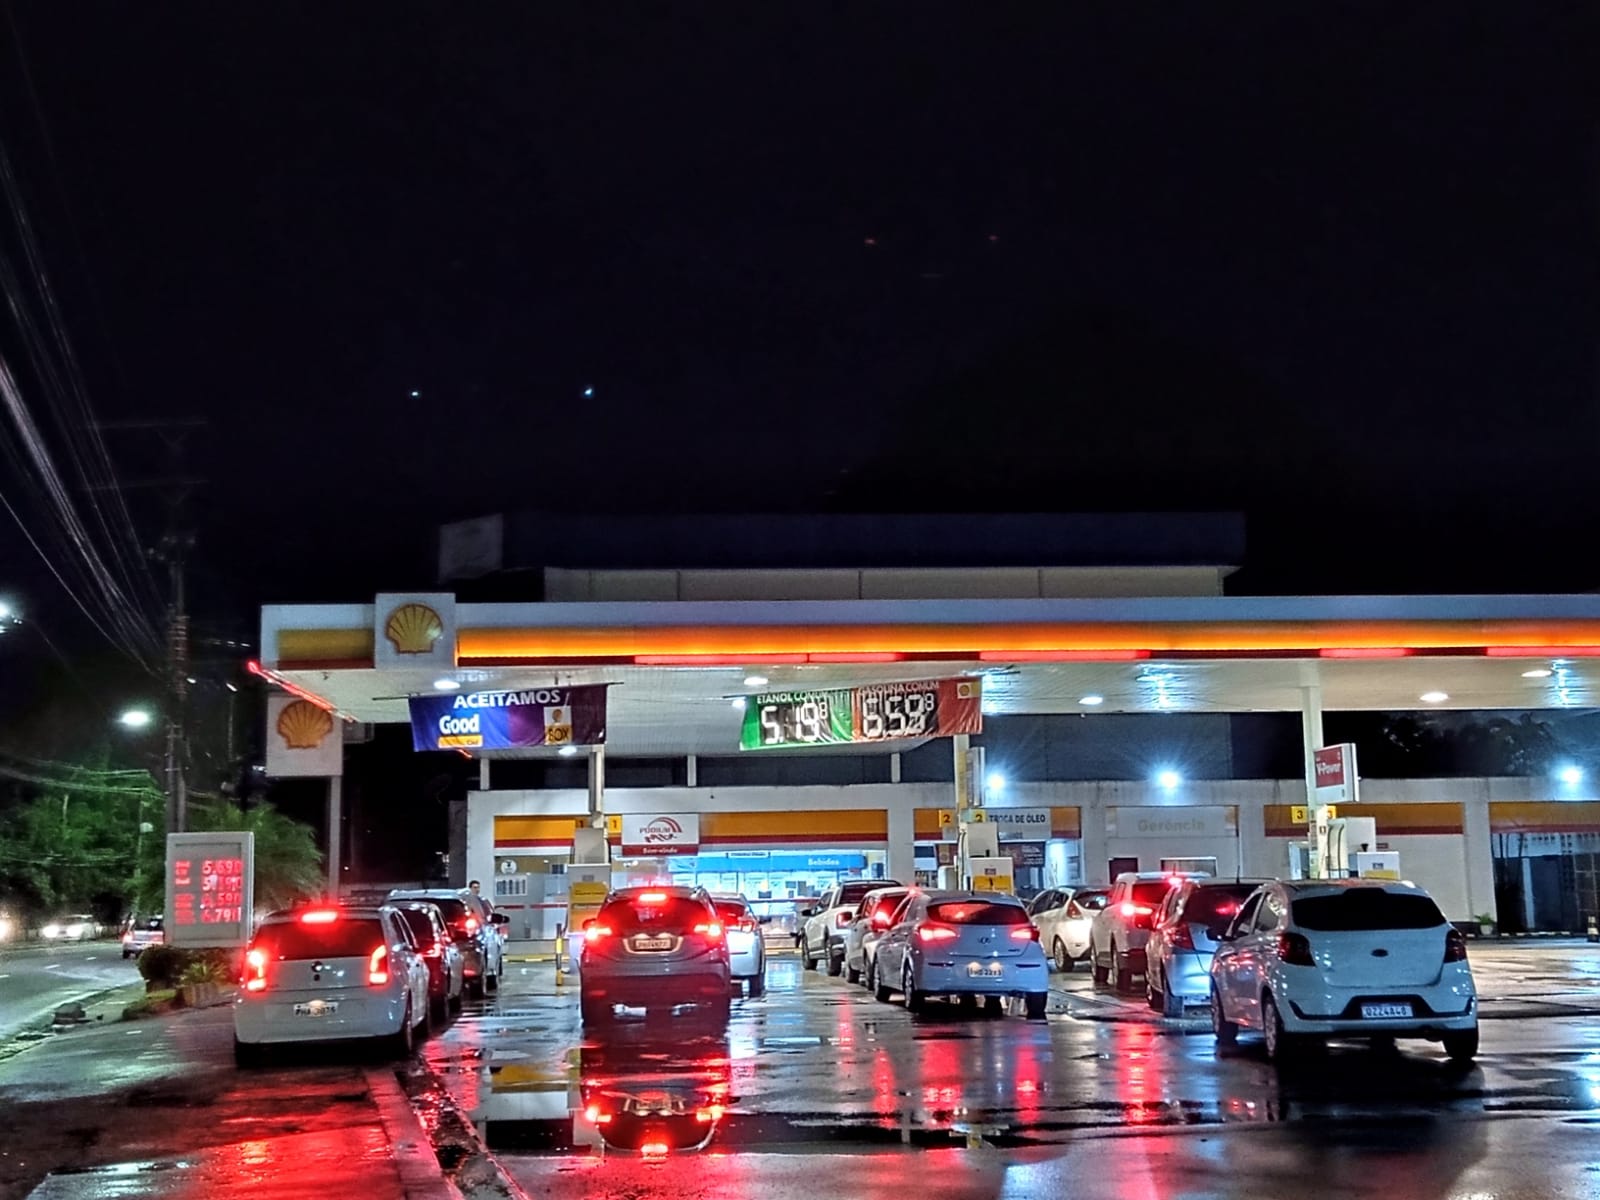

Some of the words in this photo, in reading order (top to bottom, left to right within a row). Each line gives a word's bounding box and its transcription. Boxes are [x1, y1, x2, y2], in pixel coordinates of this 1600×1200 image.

[858, 683, 904, 697] GASOLINA
[905, 681, 939, 693] COMUM
[453, 689, 561, 709] ACEITAMOS
[757, 693, 793, 705] ETANOL
[439, 714, 480, 734] Good
[943, 814, 951, 824] 2
[975, 813, 983, 823] 2
[989, 813, 1014, 823] TROCA
[1015, 813, 1025, 823] DE
[1026, 811, 1046, 823] ÓLEO
[1297, 810, 1304, 820] 3
